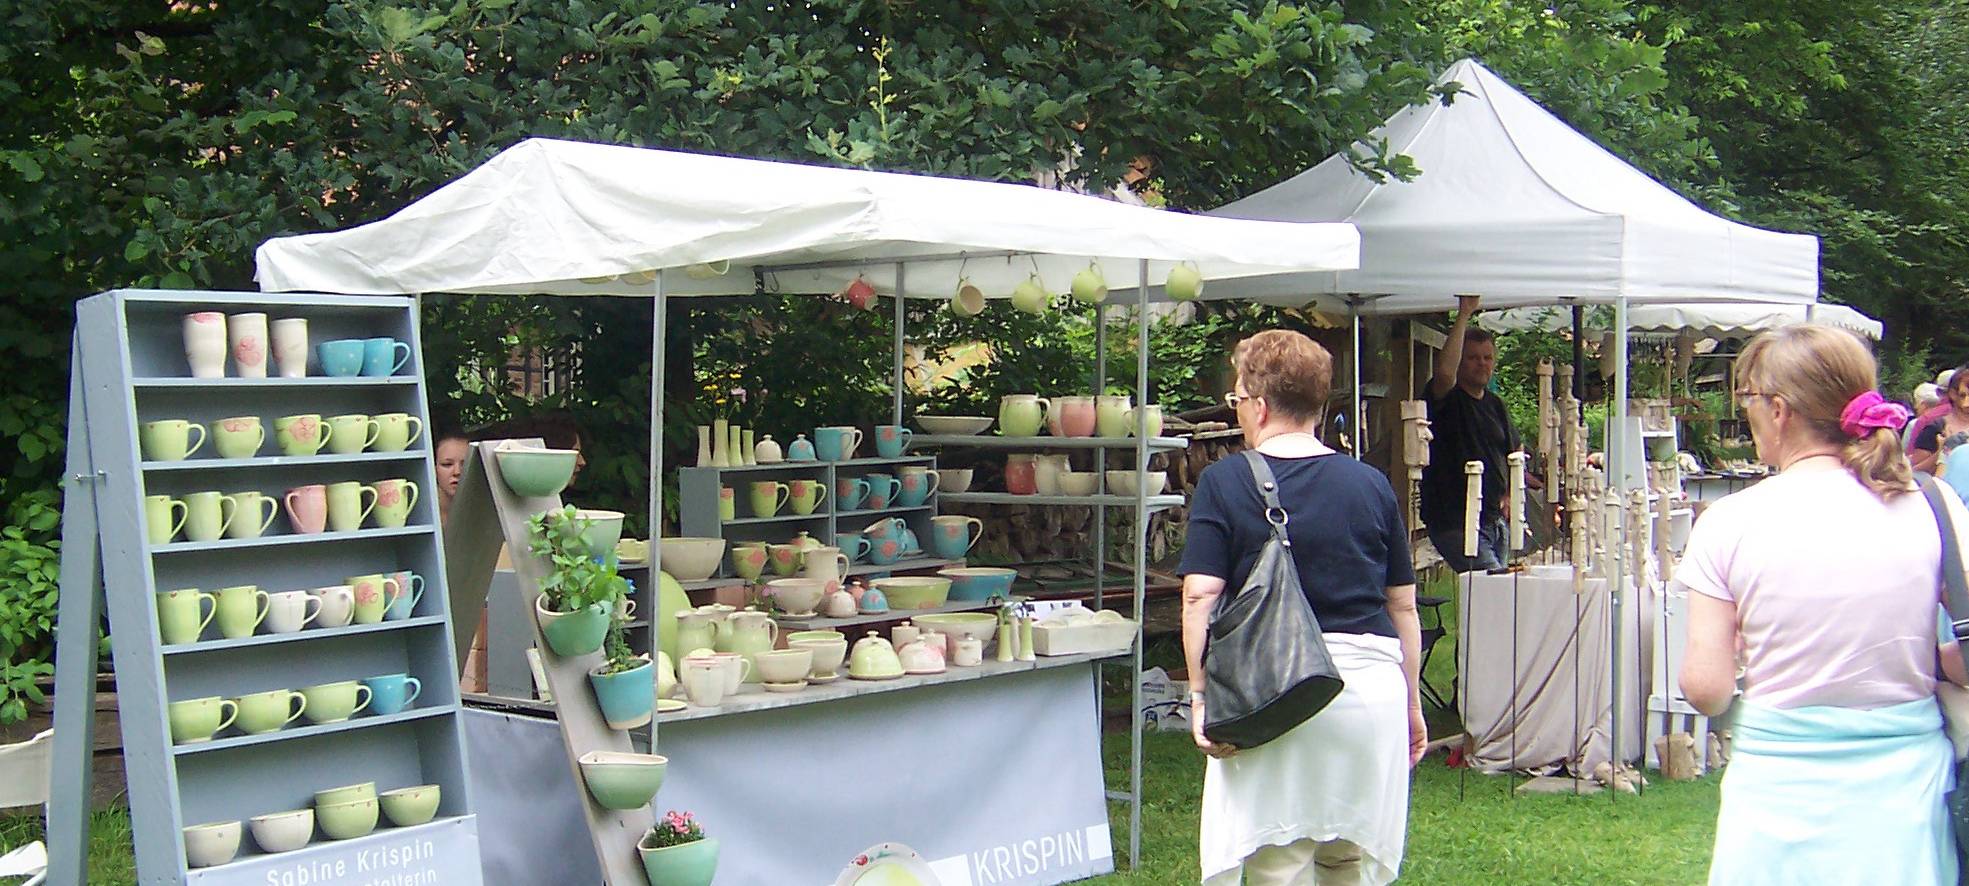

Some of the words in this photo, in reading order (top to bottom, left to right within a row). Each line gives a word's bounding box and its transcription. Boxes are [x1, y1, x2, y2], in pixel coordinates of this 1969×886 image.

[266, 859, 346, 886] Sabine
[357, 838, 434, 873] Krispin
[973, 829, 1083, 886] KRISPIN
